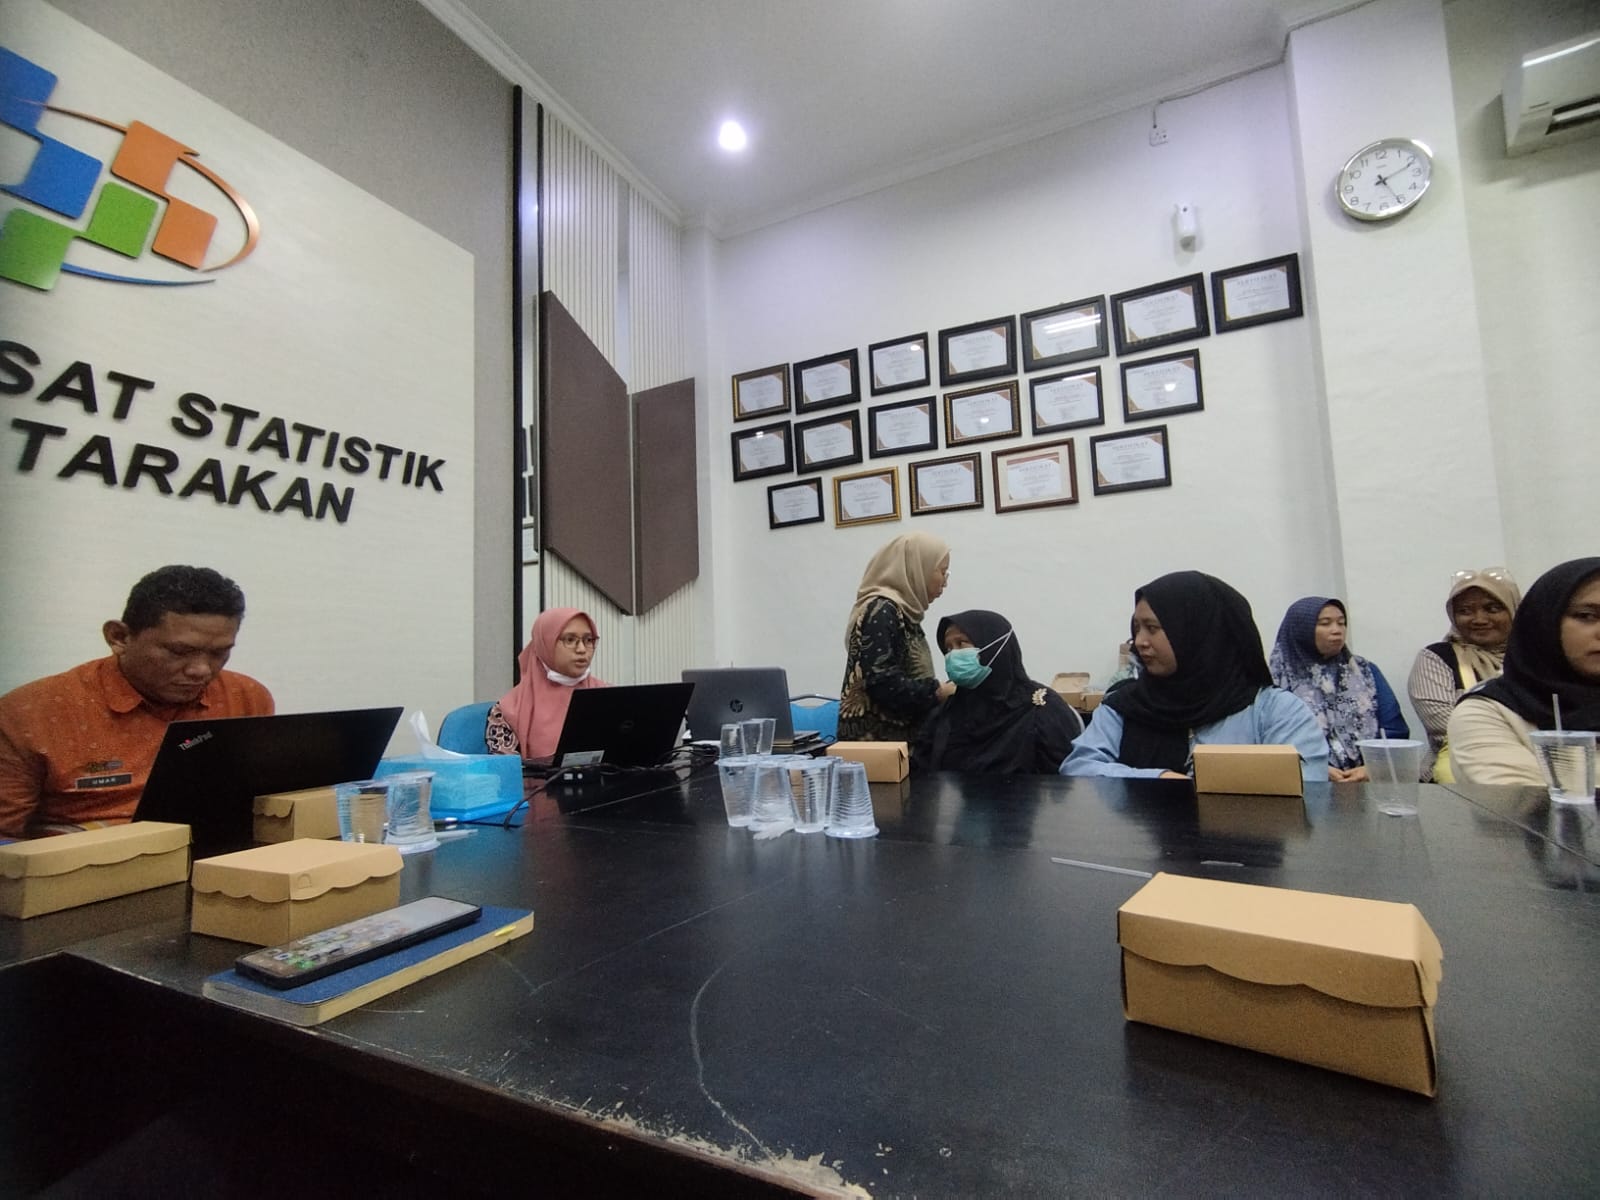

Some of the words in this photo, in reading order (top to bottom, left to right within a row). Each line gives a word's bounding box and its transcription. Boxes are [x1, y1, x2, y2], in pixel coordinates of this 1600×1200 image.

[0, 339, 156, 421] SAT
[171, 392, 446, 492] STATISTIK
[11, 418, 355, 524] TARAKAN
